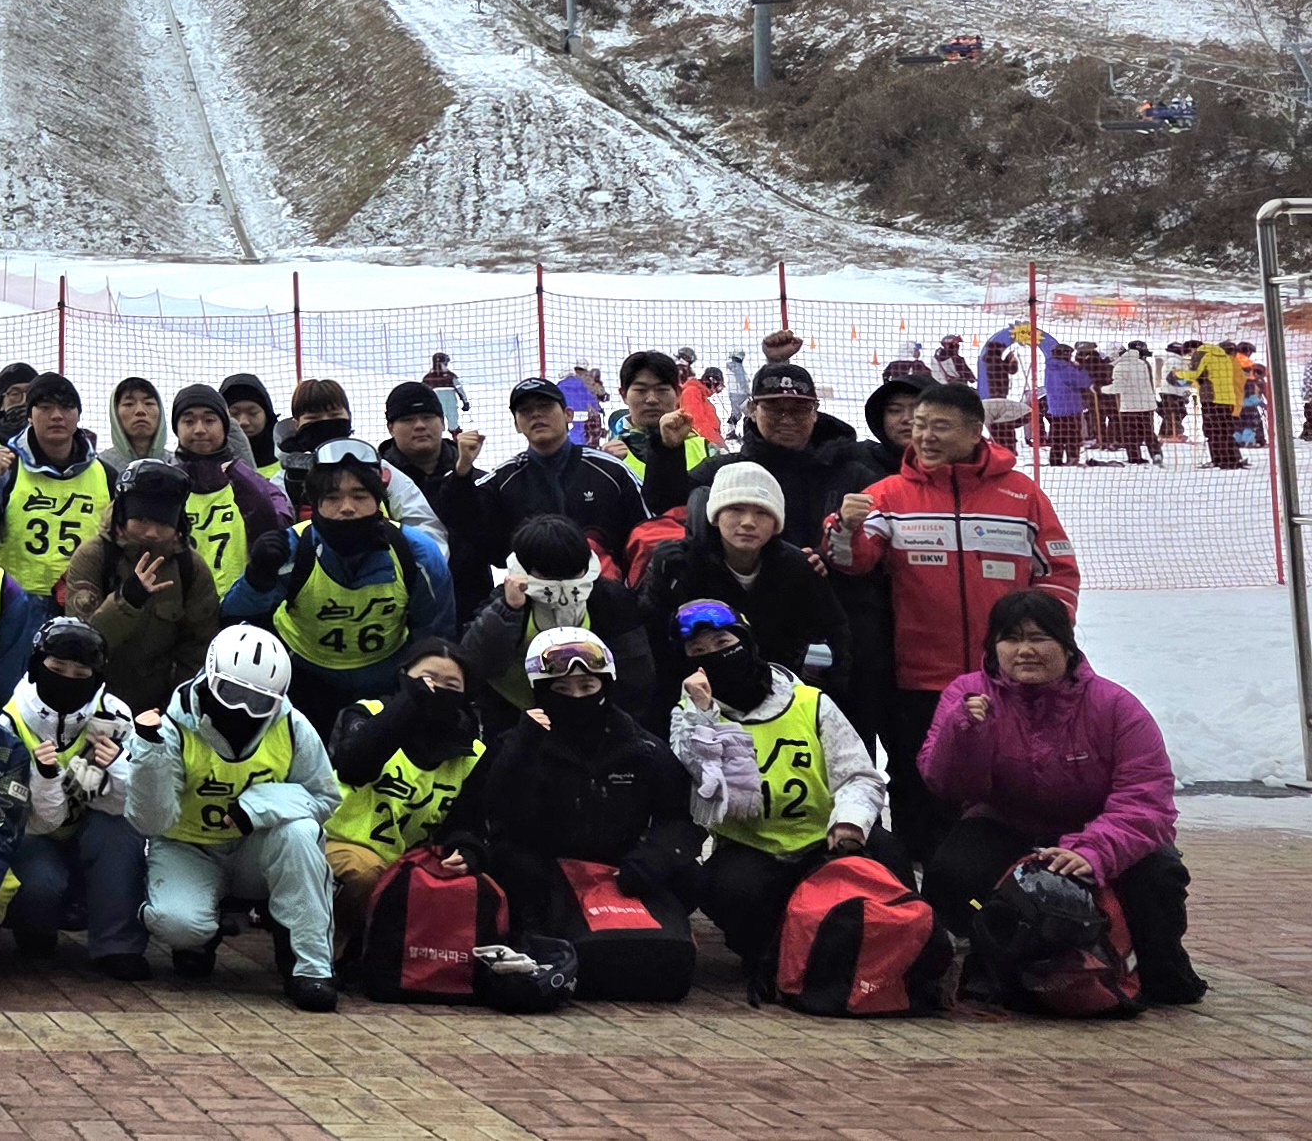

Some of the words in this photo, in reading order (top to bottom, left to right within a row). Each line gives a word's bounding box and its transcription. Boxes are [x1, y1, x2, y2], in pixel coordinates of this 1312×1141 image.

[25, 518, 82, 557] 35
[920, 555, 944, 563] BKW
[319, 624, 385, 654] 46
[761, 778, 809, 819] 12
